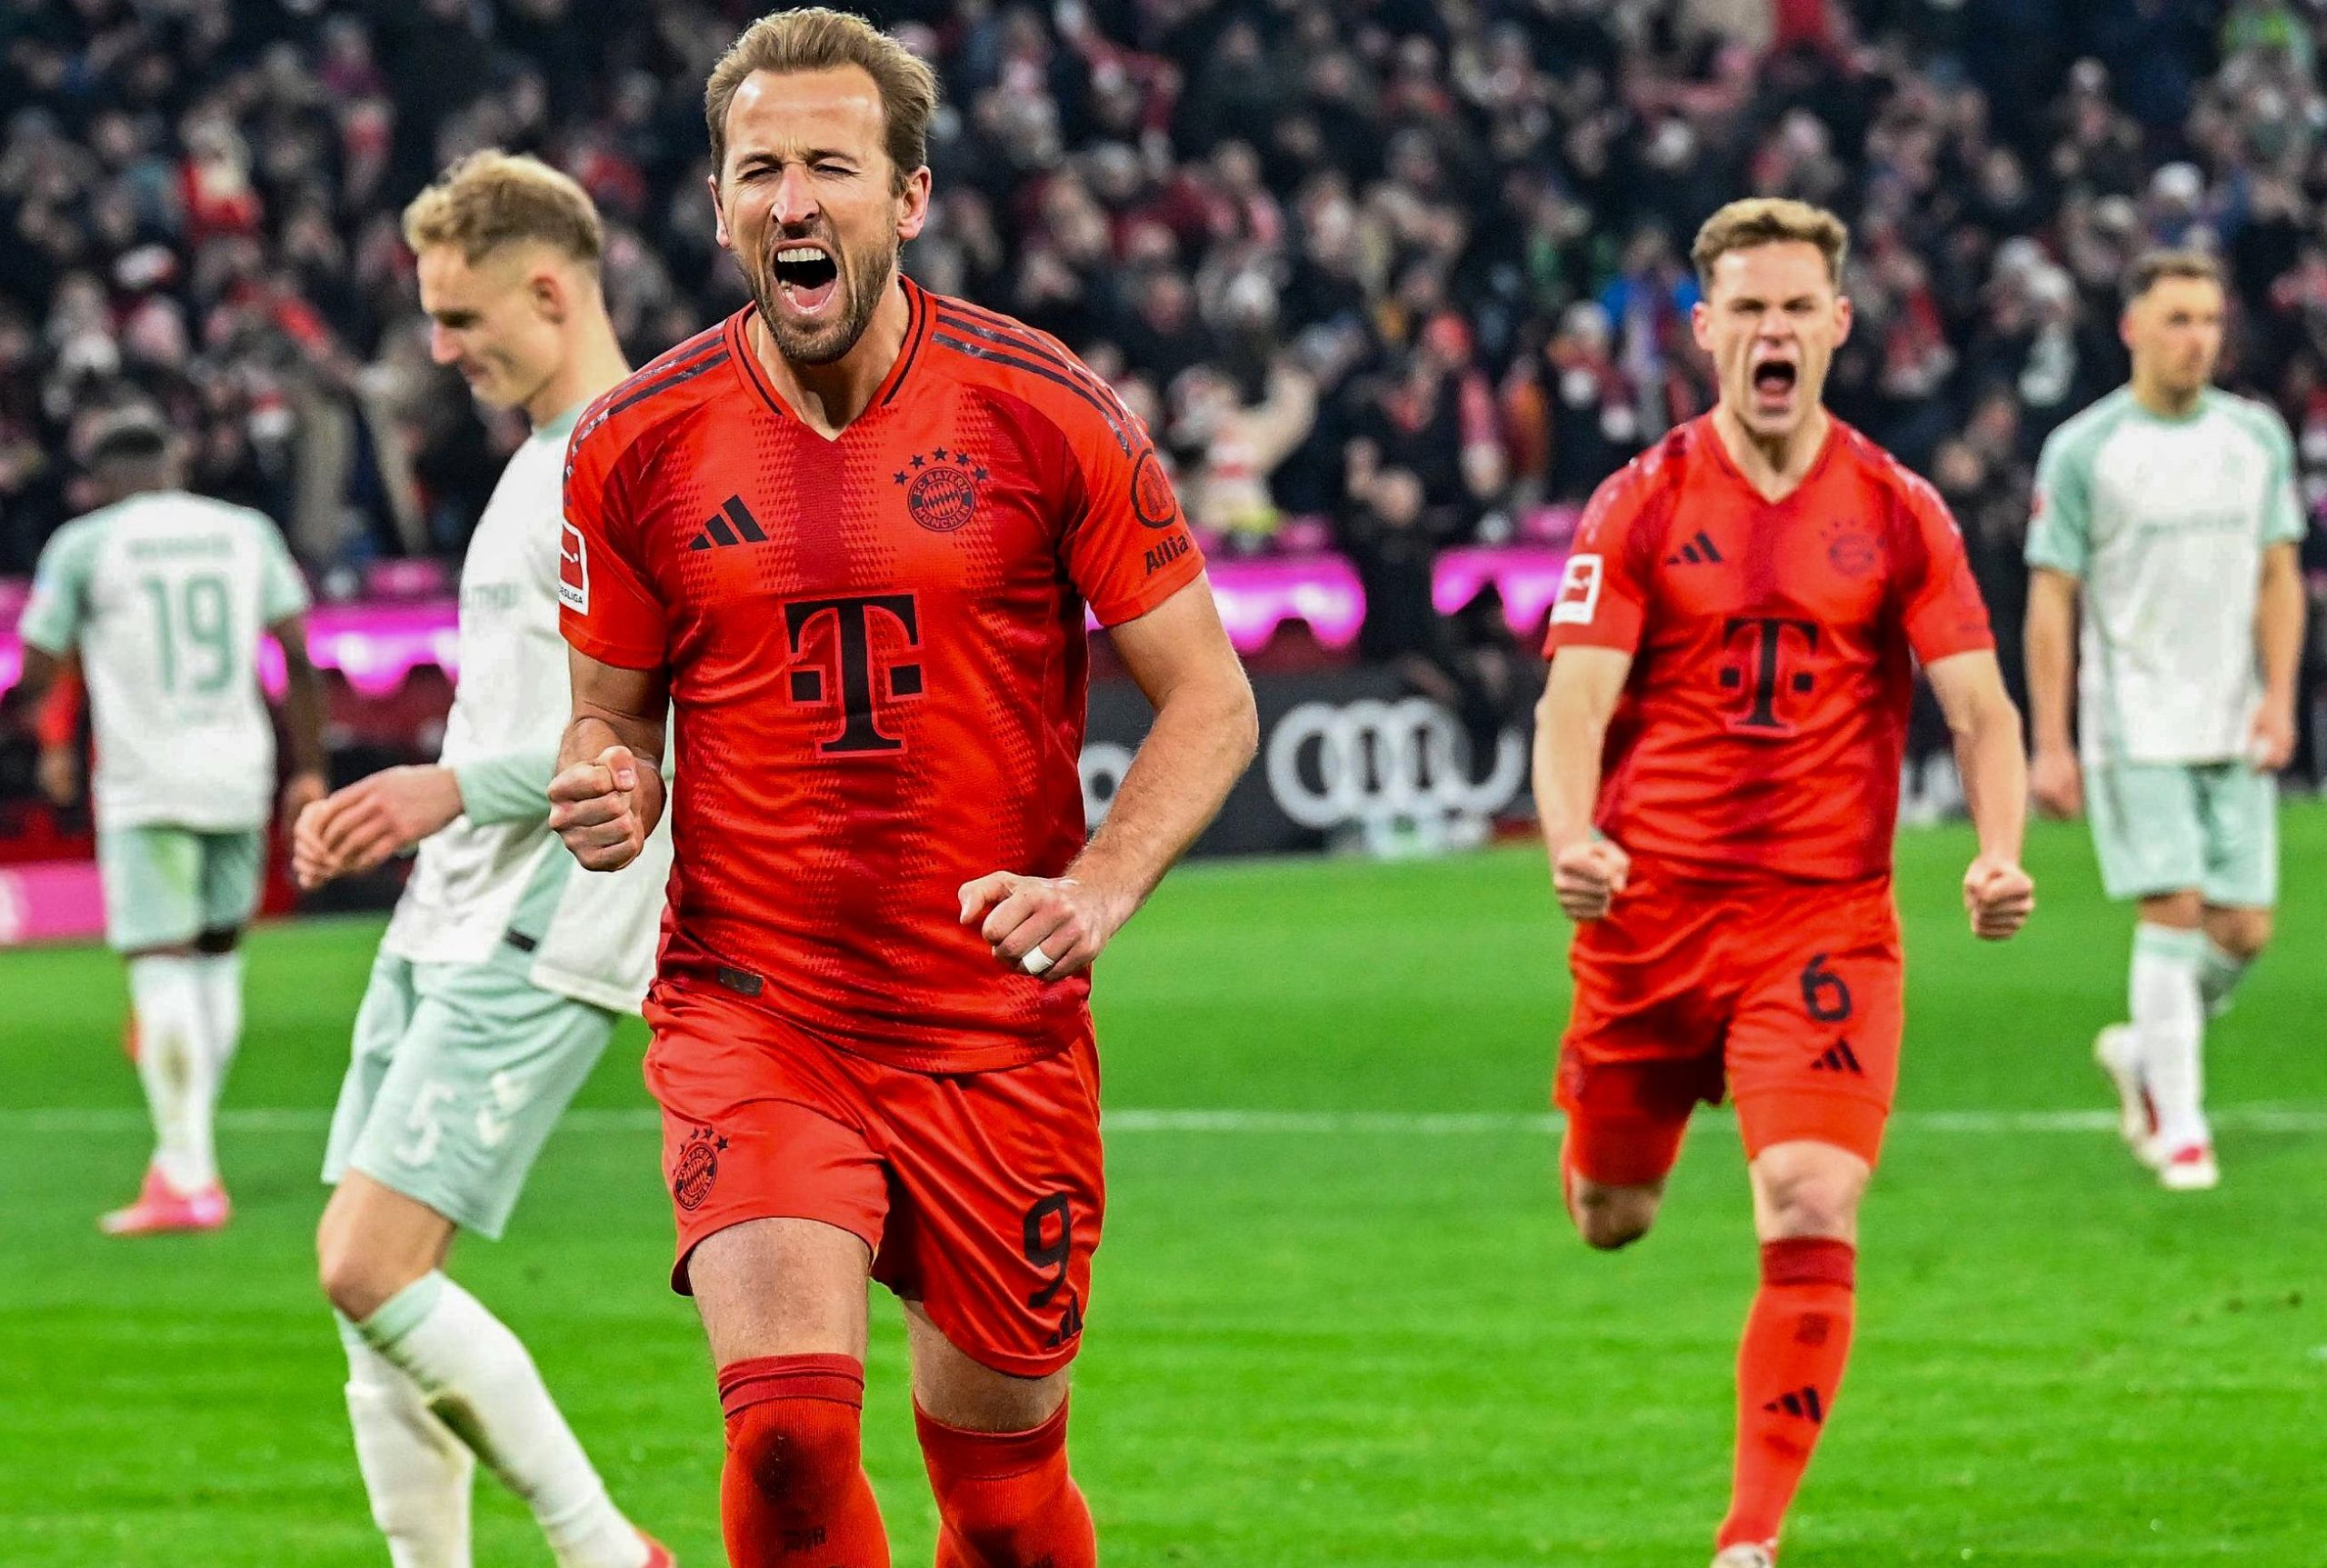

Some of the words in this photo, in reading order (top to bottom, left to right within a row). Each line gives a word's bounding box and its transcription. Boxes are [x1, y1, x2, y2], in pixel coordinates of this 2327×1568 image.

[926, 471, 969, 494] BAYERN
[1144, 531, 1192, 575] Allia
[140, 570, 234, 698] 19
[784, 594, 922, 753] T
[1722, 617, 1819, 727] T
[1801, 952, 1852, 1022] 6
[394, 1079, 454, 1166] 5
[1023, 1191, 1072, 1309] 9
